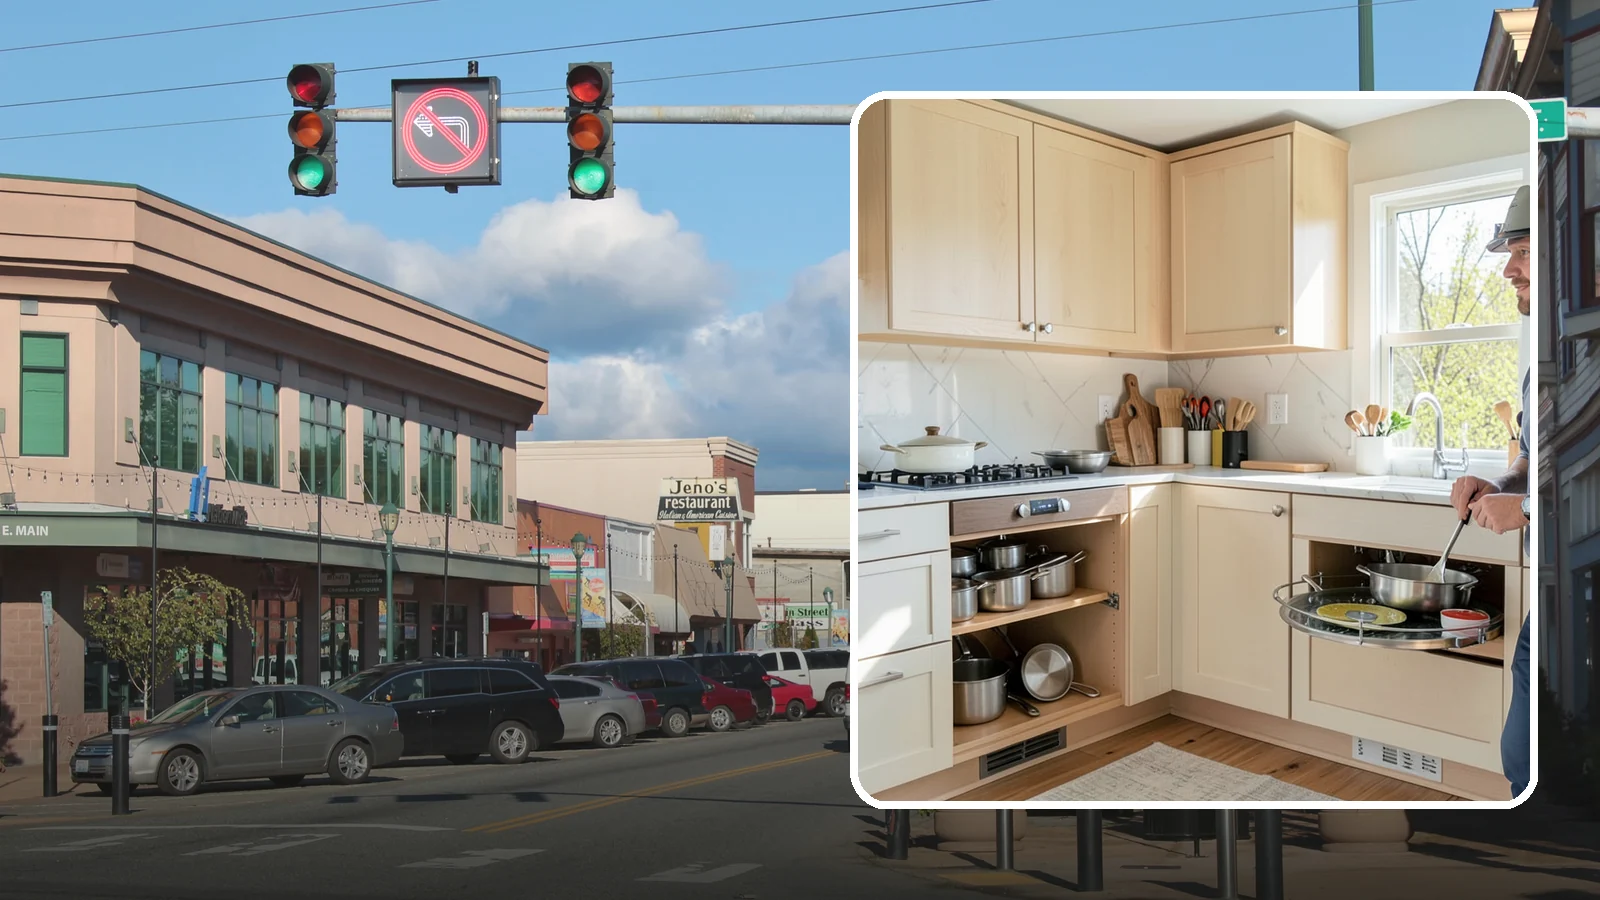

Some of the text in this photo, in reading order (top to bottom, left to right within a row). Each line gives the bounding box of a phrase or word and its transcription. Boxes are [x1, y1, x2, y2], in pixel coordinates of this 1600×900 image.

[669, 480, 728, 495] Jeno's
[665, 496, 731, 509] restaurant
[659, 509, 681, 520] Italian
[686, 509, 714, 520] American
[715, 509, 738, 520] Cuisine
[2, 525, 49, 536] E. MAIN
[797, 607, 828, 617] Street
